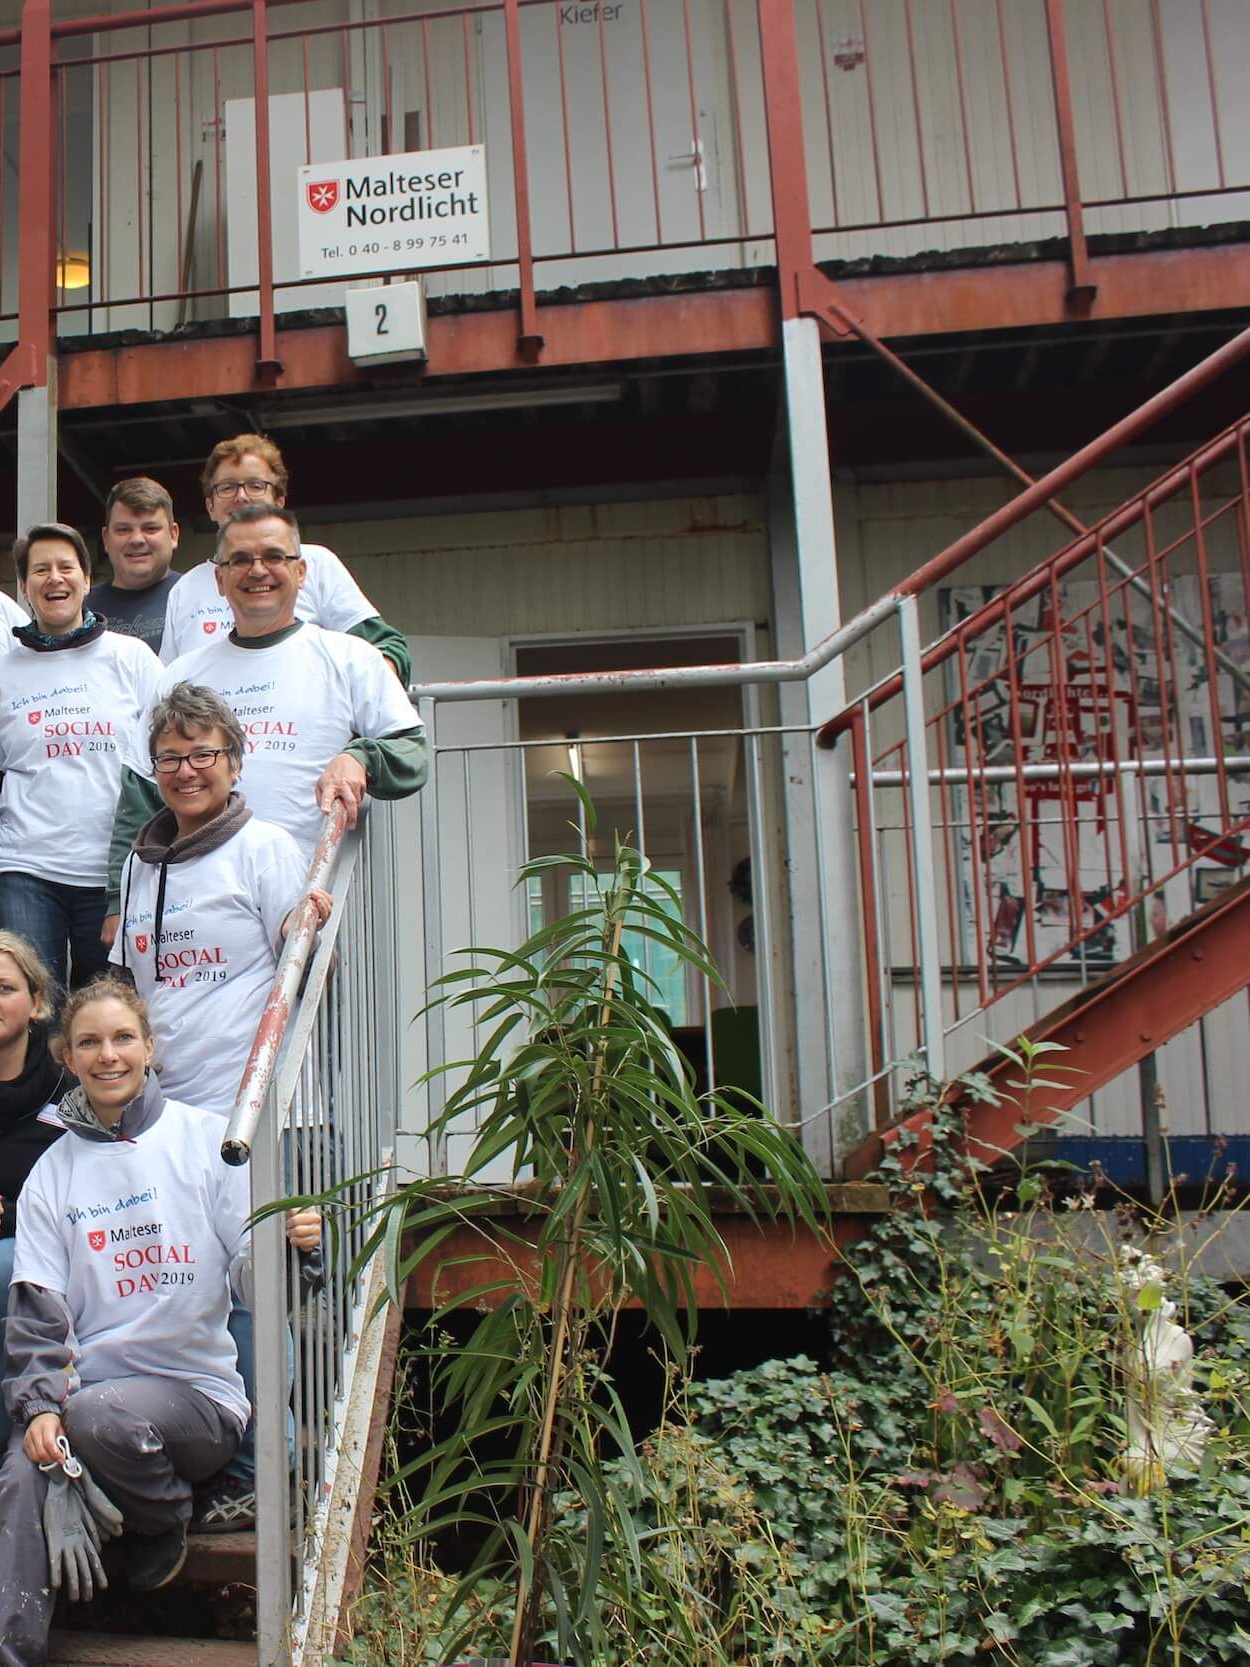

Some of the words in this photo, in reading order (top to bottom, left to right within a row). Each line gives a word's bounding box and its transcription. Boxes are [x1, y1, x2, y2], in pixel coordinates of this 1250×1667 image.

[560, 3, 623, 24] Kiefer
[346, 170, 464, 200] Malteser
[347, 192, 478, 227] Nordlicht
[321, 247, 344, 259] Tel.
[349, 244, 357, 256] 0
[362, 242, 380, 254] 40
[393, 239, 401, 251] 8
[406, 237, 424, 249] 99
[430, 235, 447, 247] 75
[452, 233, 468, 244] 41
[375, 303, 389, 335] 2
[12, 698, 29, 711] Ich
[31, 693, 48, 703] bin
[44, 705, 91, 719] Malteser
[44, 721, 116, 738] SOCIAL
[239, 721, 298, 736] OCIAL
[46, 741, 84, 759] DAY
[89, 741, 117, 752] 2019
[264, 740, 296, 752] 2019
[195, 970, 227, 982] 2019
[88, 1204, 111, 1218] bin
[114, 1186, 158, 1212] dabei!
[110, 1222, 164, 1243] Malteser
[114, 1244, 196, 1272] SOCIAL
[115, 1273, 160, 1298] DAY
[161, 1272, 195, 1285] 2019
